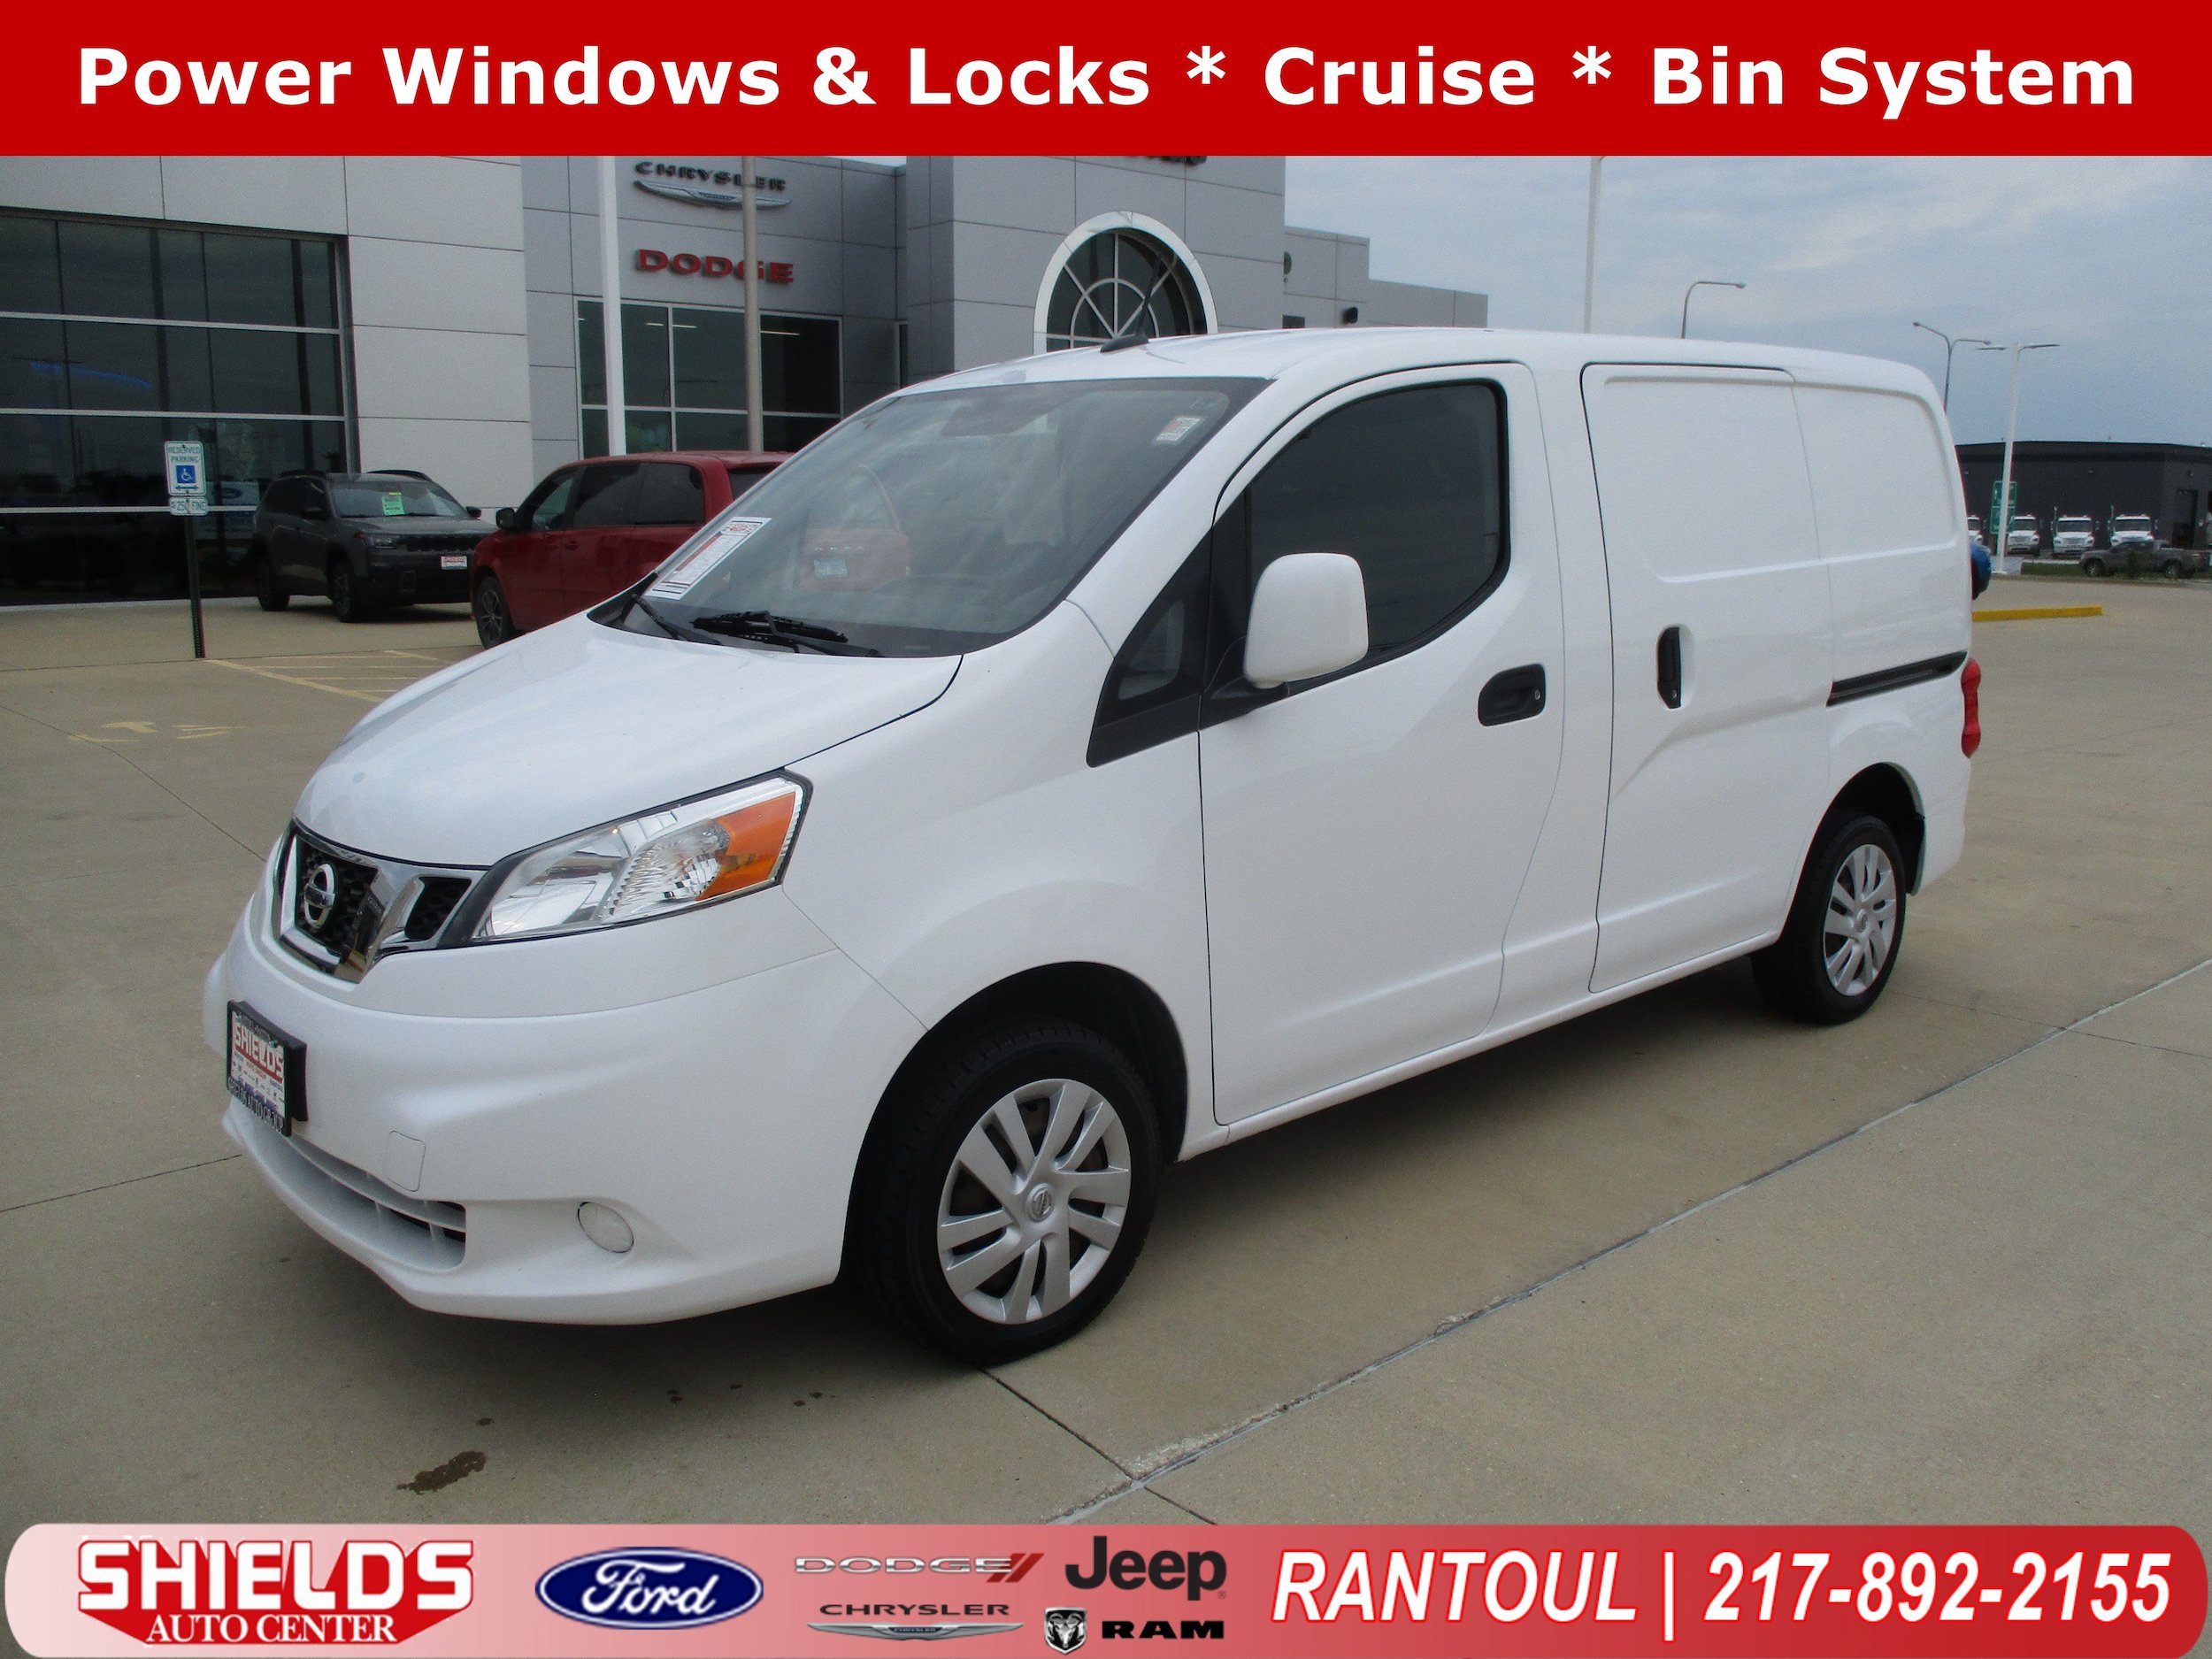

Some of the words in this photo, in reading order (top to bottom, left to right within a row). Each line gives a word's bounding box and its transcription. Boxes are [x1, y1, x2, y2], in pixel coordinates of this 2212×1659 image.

[634, 161, 786, 191] CHRYSLER
[638, 249, 794, 283] DODGE
[234, 1024, 284, 1077] SHIELDS
